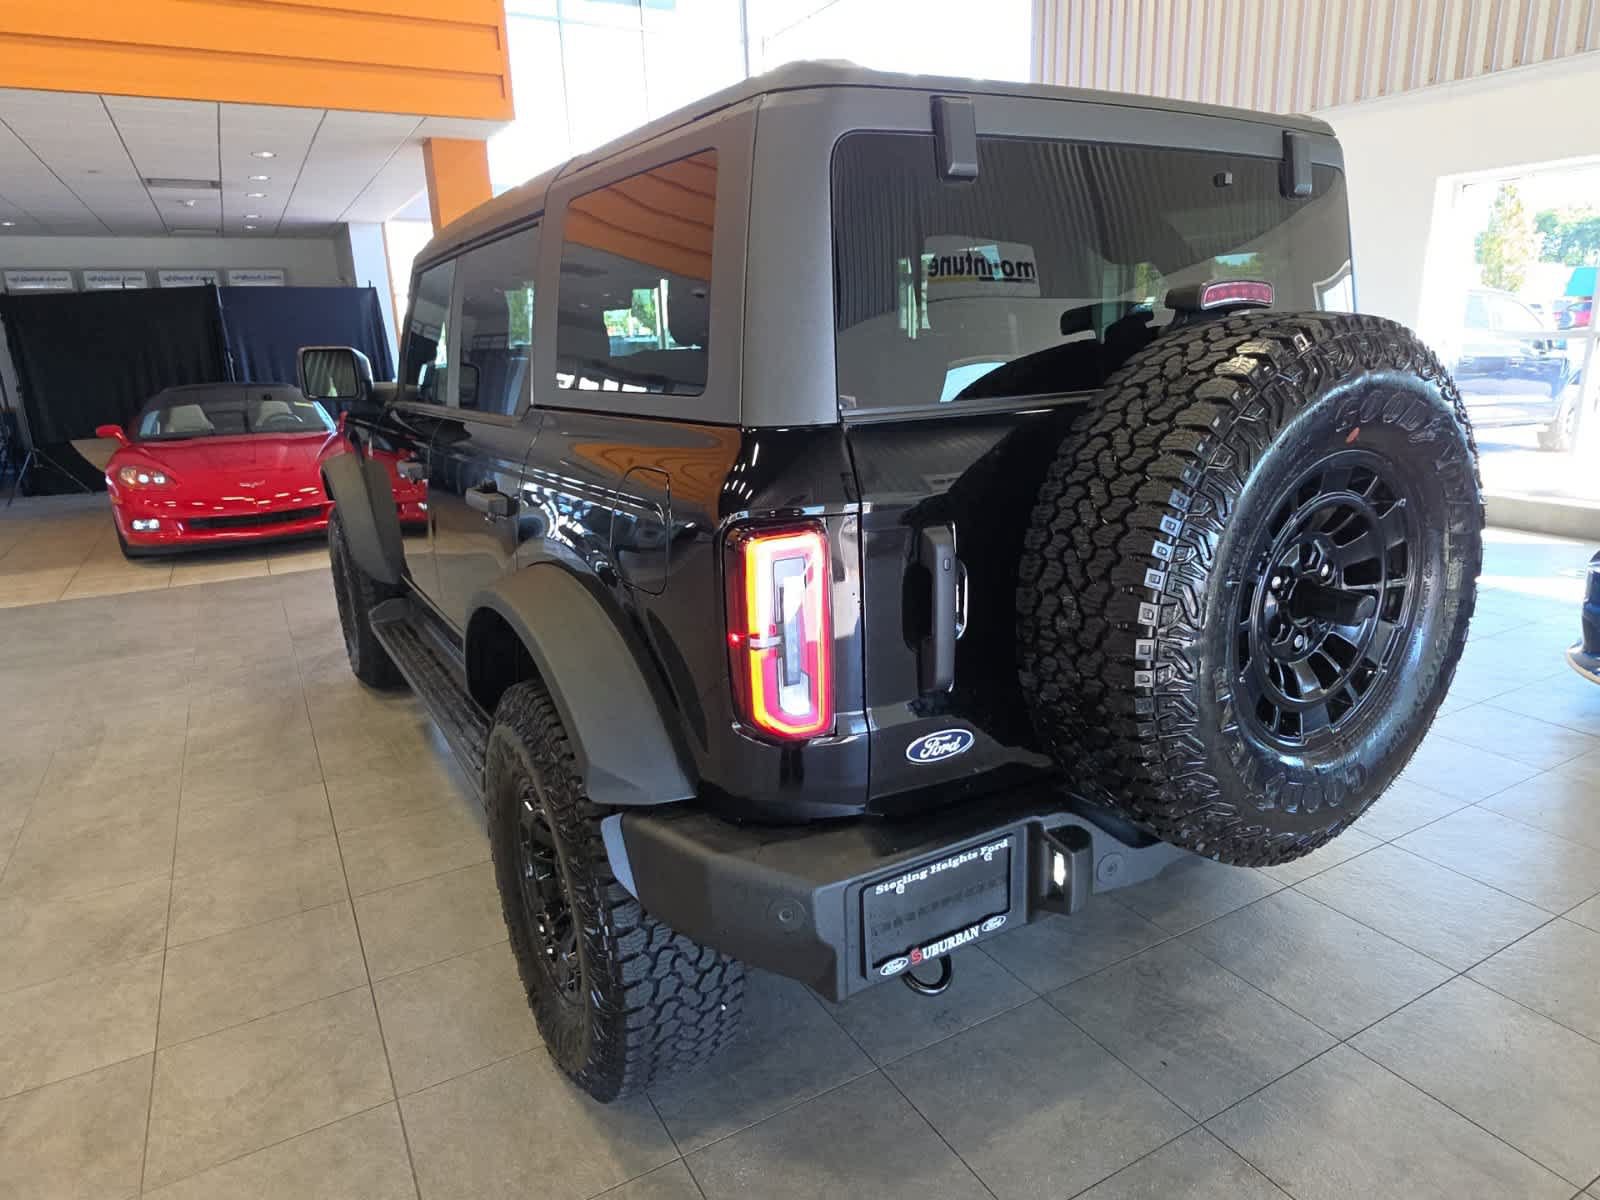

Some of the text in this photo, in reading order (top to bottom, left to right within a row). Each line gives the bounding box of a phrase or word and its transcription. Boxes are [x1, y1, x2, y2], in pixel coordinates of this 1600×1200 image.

[919, 734, 962, 759] Ford
[875, 838, 1009, 895] Sterling Heights Ford
[910, 925, 981, 966] SUBURBAN
